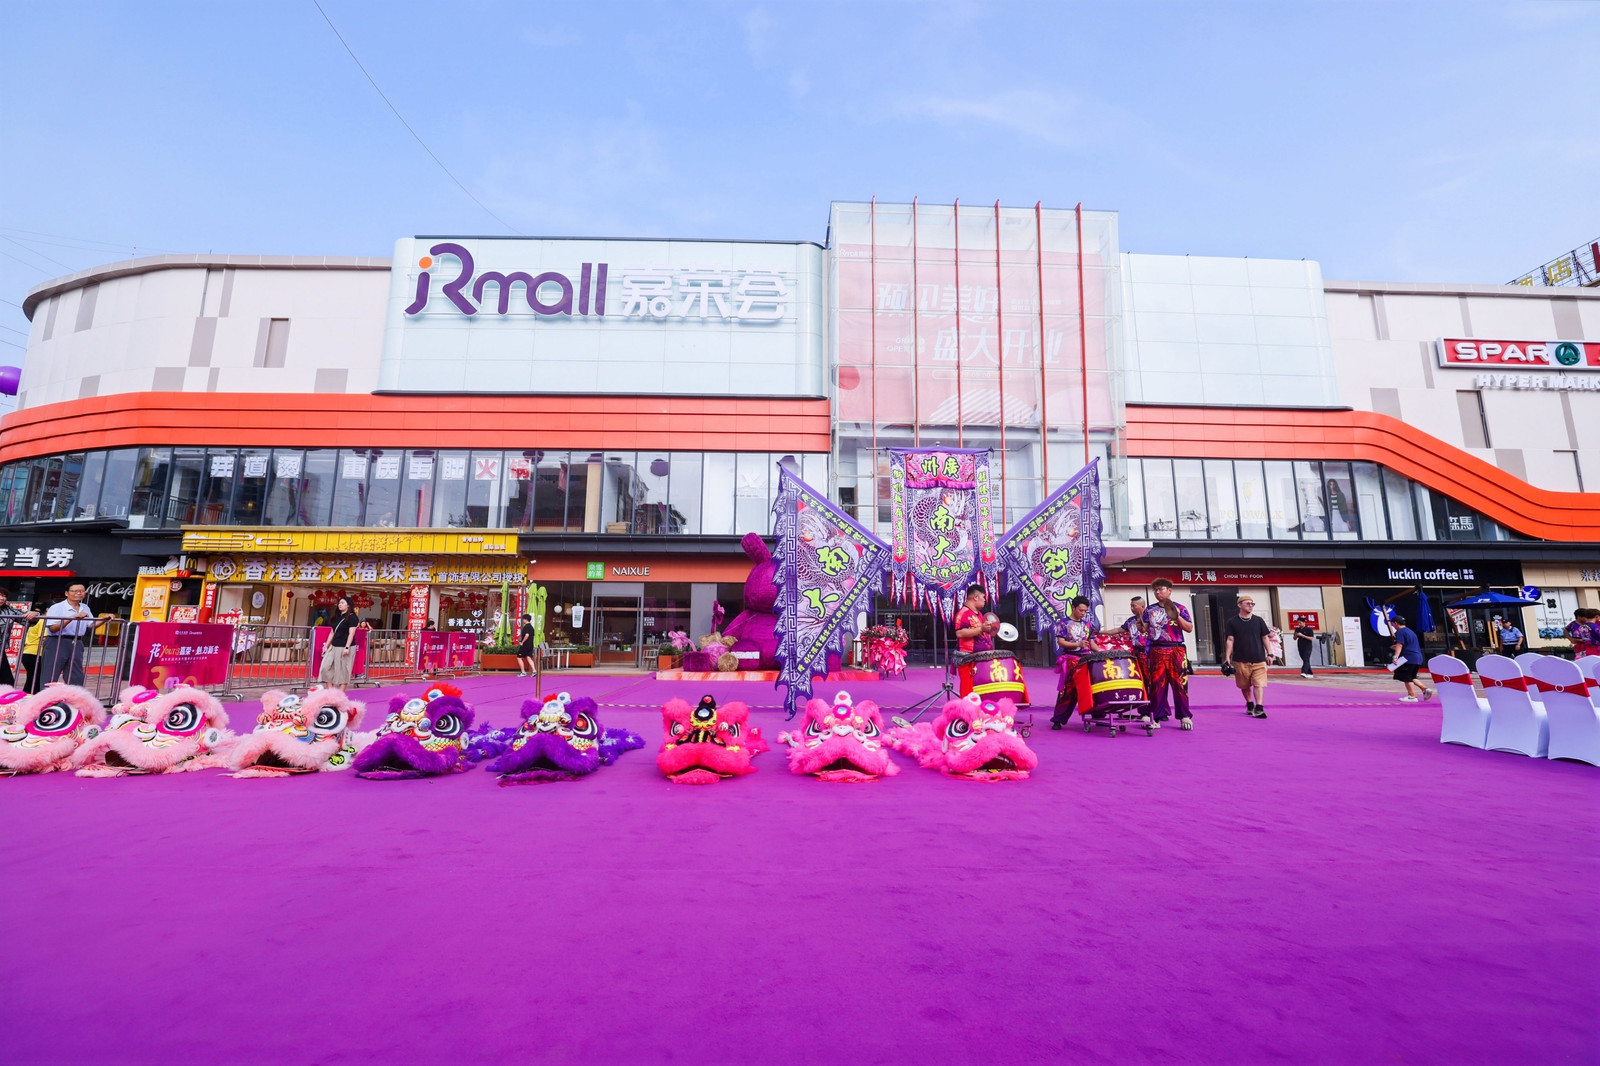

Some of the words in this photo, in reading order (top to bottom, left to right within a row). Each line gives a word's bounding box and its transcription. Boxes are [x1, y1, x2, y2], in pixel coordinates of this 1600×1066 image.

[932, 326, 1064, 365] 盛大开业
[1454, 342, 1550, 363] SPAR
[1475, 373, 1546, 388] HYPER
[242, 557, 435, 582] 香港金六福珠宝
[612, 567, 650, 576] NAIXUE
[1182, 571, 1217, 582] 周大福
[1387, 568, 1421, 580] luckin
[1424, 568, 1459, 580] coffee
